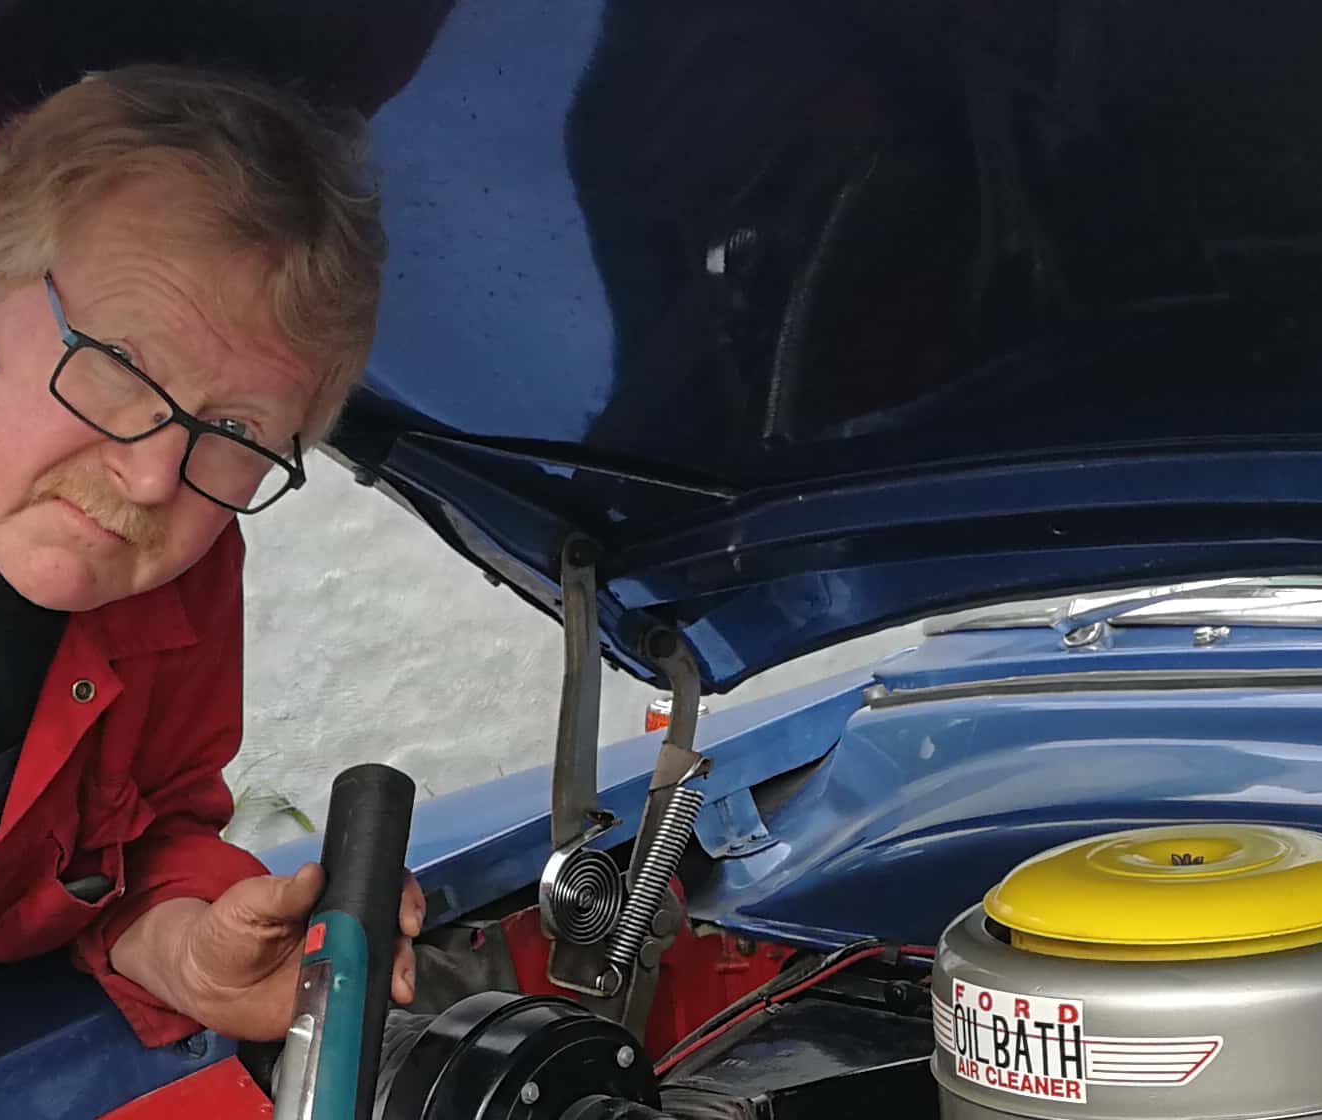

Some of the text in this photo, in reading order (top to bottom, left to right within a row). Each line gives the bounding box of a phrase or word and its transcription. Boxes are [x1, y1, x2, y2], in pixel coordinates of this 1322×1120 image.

[955, 984, 1078, 1024] FORD
[954, 1003, 1082, 1079] OIL BATH
[958, 1056, 1081, 1099] AIR CLEANER
